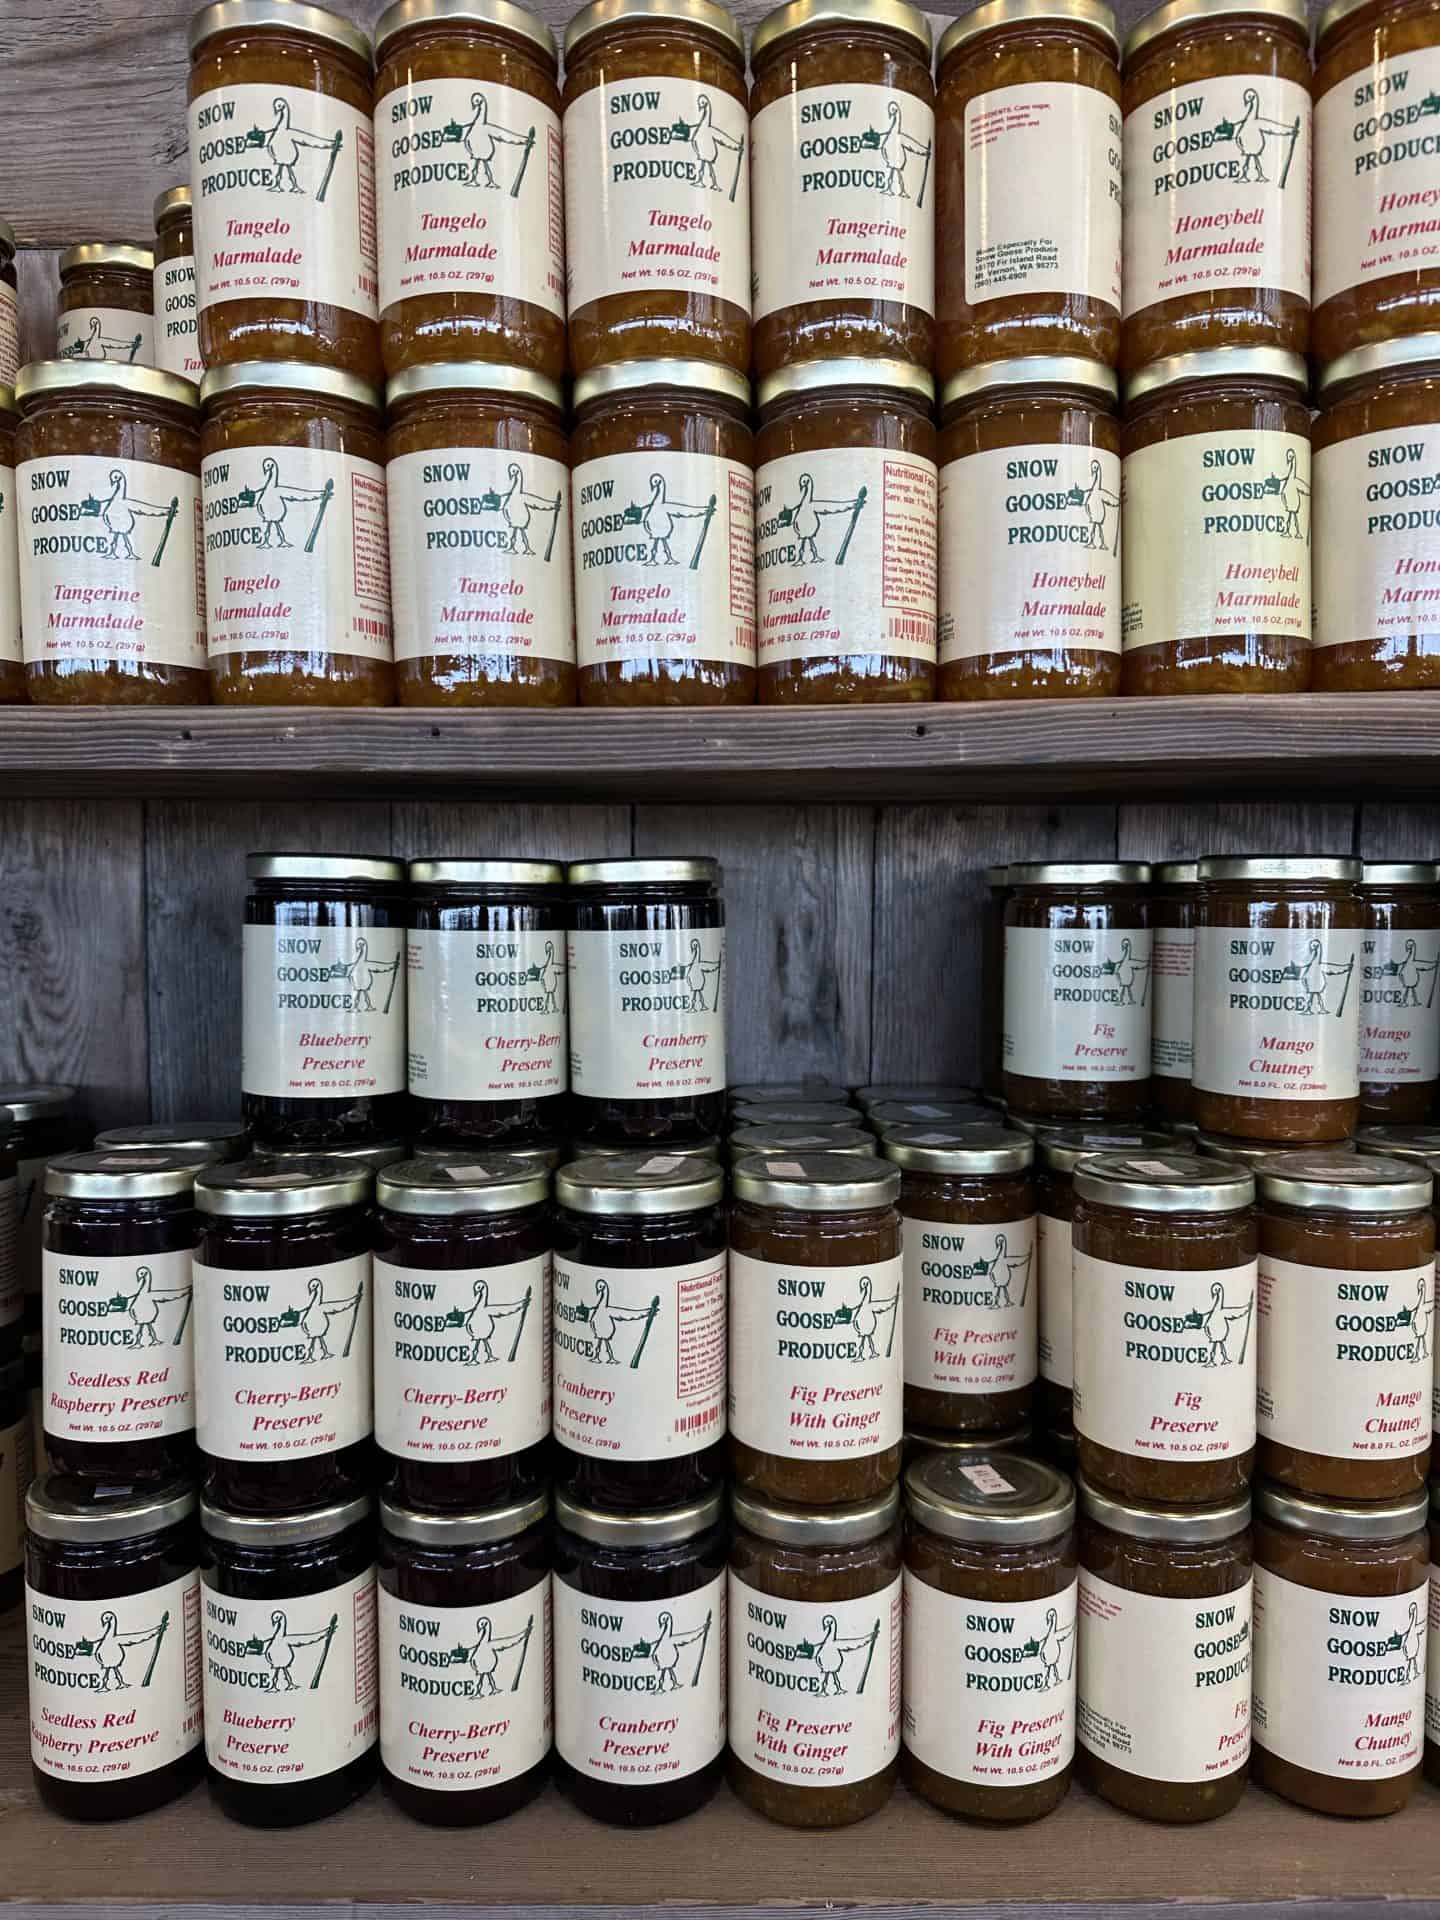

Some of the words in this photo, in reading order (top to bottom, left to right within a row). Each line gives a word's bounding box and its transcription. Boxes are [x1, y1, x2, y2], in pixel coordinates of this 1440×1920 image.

[1354, 71, 1408, 107] SNOW
[610, 92, 660, 115] SNOW
[800, 100, 852, 124] SNOW
[1154, 97, 1204, 129] SNOW
[198, 102, 236, 128] SNOW
[1354, 105, 1419, 142] GOOSE
[610, 127, 672, 149] GOOSE
[800, 135, 862, 159] GOOSE
[200, 136, 245, 164] GOOSE
[1152, 131, 1214, 165] GOOSE
[613, 160, 697, 183] PRODUCE
[802, 169, 885, 192] PRODUCE
[1154, 160, 1240, 197] PRODUCE
[202, 169, 273, 196] PRODUCE
[226, 218, 290, 237] Tangelo
[420, 213, 486, 231] Tangelo
[648, 209, 712, 232] Tangelo
[827, 218, 907, 240] Tangerine
[1175, 208, 1264, 235] Honeybell
[213, 246, 302, 269] Marmalade
[406, 242, 497, 263] Marmalade
[628, 239, 720, 263] Marmalade
[816, 247, 907, 269] Marmalade
[1166, 238, 1264, 266] Marmalade
[809, 280, 824, 289] Net
[844, 277, 862, 286] 10.5
[1203, 448, 1255, 468] SNOW
[1007, 459, 1058, 479] SNOW
[32, 470, 70, 491] SNOW
[580, 480, 614, 505] SNOW
[1202, 482, 1264, 501] GOOSE
[1006, 494, 1067, 512] GOOSE
[31, 503, 81, 524] GOOSE
[581, 513, 625, 539] GOOSE
[1204, 515, 1285, 534] PRODUCE
[1008, 525, 1088, 545] PRODUCE
[33, 535, 108, 556] PRODUCE
[583, 543, 647, 569] PRODUCE
[1031, 572, 1106, 591] Honeybell
[1225, 563, 1299, 583] Honeybell
[54, 584, 140, 604] Tangerine
[458, 577, 524, 596] Tangelo
[610, 584, 671, 602] Tangelo
[1216, 590, 1300, 608] Marmalade
[440, 606, 534, 625] Marmalade
[601, 609, 686, 626] Marmalade
[1021, 600, 1106, 618] Marmalade
[48, 613, 144, 631] Marmalade
[278, 939, 321, 954] SNOW
[620, 943, 661, 957] SNOW
[1054, 940, 1094, 953] SNOW
[1230, 940, 1274, 955] SNOW
[278, 967, 329, 982] GOOSE
[620, 971, 671, 985] GOOSE
[1053, 964, 1100, 978] GOOSE
[1229, 969, 1283, 984] GOOSE
[278, 994, 352, 1009] PRODUCE
[622, 996, 689, 1011] PRODUCE
[1054, 988, 1119, 1002] PRODUCE
[1229, 994, 1305, 1010] PRODUCE
[1093, 1023, 1115, 1038] Fig
[299, 1034, 371, 1048] Blueberry
[643, 1034, 708, 1048] Cranberry
[1075, 1044, 1128, 1057] Preserve
[1260, 1037, 1314, 1054] Mango
[302, 1057, 365, 1070] Preserve
[502, 1059, 552, 1072] Preserve
[649, 1057, 703, 1070] Preserve
[1249, 1060, 1313, 1078] Chutney
[59, 1268, 99, 1287] SNOW
[224, 1285, 270, 1302] SNOW
[778, 1280, 825, 1298] SNOW
[1125, 1281, 1174, 1301] SNOW
[1338, 1284, 1389, 1301] SNOW
[59, 1299, 109, 1317] GOOSE
[223, 1316, 280, 1333] GOOSE
[777, 1310, 834, 1330] GOOSE
[1124, 1312, 1184, 1333] GOOSE
[1336, 1315, 1397, 1332] GOOSE
[60, 1328, 133, 1345] PRODUCE
[225, 1344, 305, 1363] PRODUCE
[778, 1340, 857, 1359] PRODUCE
[1126, 1341, 1208, 1363] PRODUCE
[1336, 1343, 1415, 1361] PRODUCE
[68, 1372, 130, 1387] Seedless
[137, 1368, 169, 1385] Red
[51, 1393, 116, 1415] Raspberry
[122, 1391, 188, 1411] Preserve
[235, 1381, 341, 1407] Cherry-Berry
[404, 1386, 507, 1407] Cherry-Berry
[790, 1386, 817, 1405] Fig
[823, 1384, 882, 1404] Preserve
[1174, 1392, 1202, 1409] Fig
[1376, 1391, 1422, 1408] Mango
[253, 1412, 322, 1431] Preserve
[419, 1415, 488, 1431] Preserve
[559, 1401, 607, 1428] Preserve
[790, 1412, 826, 1429] With
[833, 1411, 880, 1431] Ginger
[1150, 1417, 1218, 1432] Preserve
[1365, 1416, 1421, 1434] Chutney
[790, 1439, 804, 1447] Net
[825, 1439, 840, 1448] 10.5
[32, 1605, 66, 1629] SNOW
[400, 1614, 441, 1636] SNOW
[581, 1609, 624, 1632] SNOW
[748, 1602, 787, 1629] SNOW
[1329, 1608, 1379, 1626] SNOW
[33, 1635, 76, 1660] GOOSE
[399, 1645, 449, 1667] GOOSE
[581, 1640, 633, 1662] GOOSE
[747, 1634, 796, 1661] GOOSE
[1328, 1639, 1387, 1657] GOOSE
[35, 1663, 100, 1689] PRODUCE
[583, 1667, 656, 1691] PRODUCE
[749, 1660, 819, 1692] PRODUCE
[1328, 1666, 1407, 1685] PRODUCE
[401, 1675, 474, 1696] PRODUCE
[40, 1707, 96, 1729] Seedless
[103, 1711, 136, 1728] Red
[599, 1716, 679, 1734] Cranberry
[757, 1710, 780, 1732] Fig
[785, 1717, 852, 1736] Preserve
[978, 1720, 1005, 1738] Fig
[1012, 1710, 1064, 1734] Preserve
[1365, 1710, 1412, 1728] Mango
[409, 1719, 510, 1743] Cherry-Berry
[1355, 1731, 1411, 1750] Chutney
[89, 1731, 159, 1753] Preserve
[603, 1739, 669, 1756] Preserve
[756, 1731, 788, 1754] With
[793, 1742, 848, 1762] Ginger
[975, 1741, 1012, 1758] With
[1019, 1734, 1062, 1757] Ginger
[422, 1747, 489, 1764] Preserve
